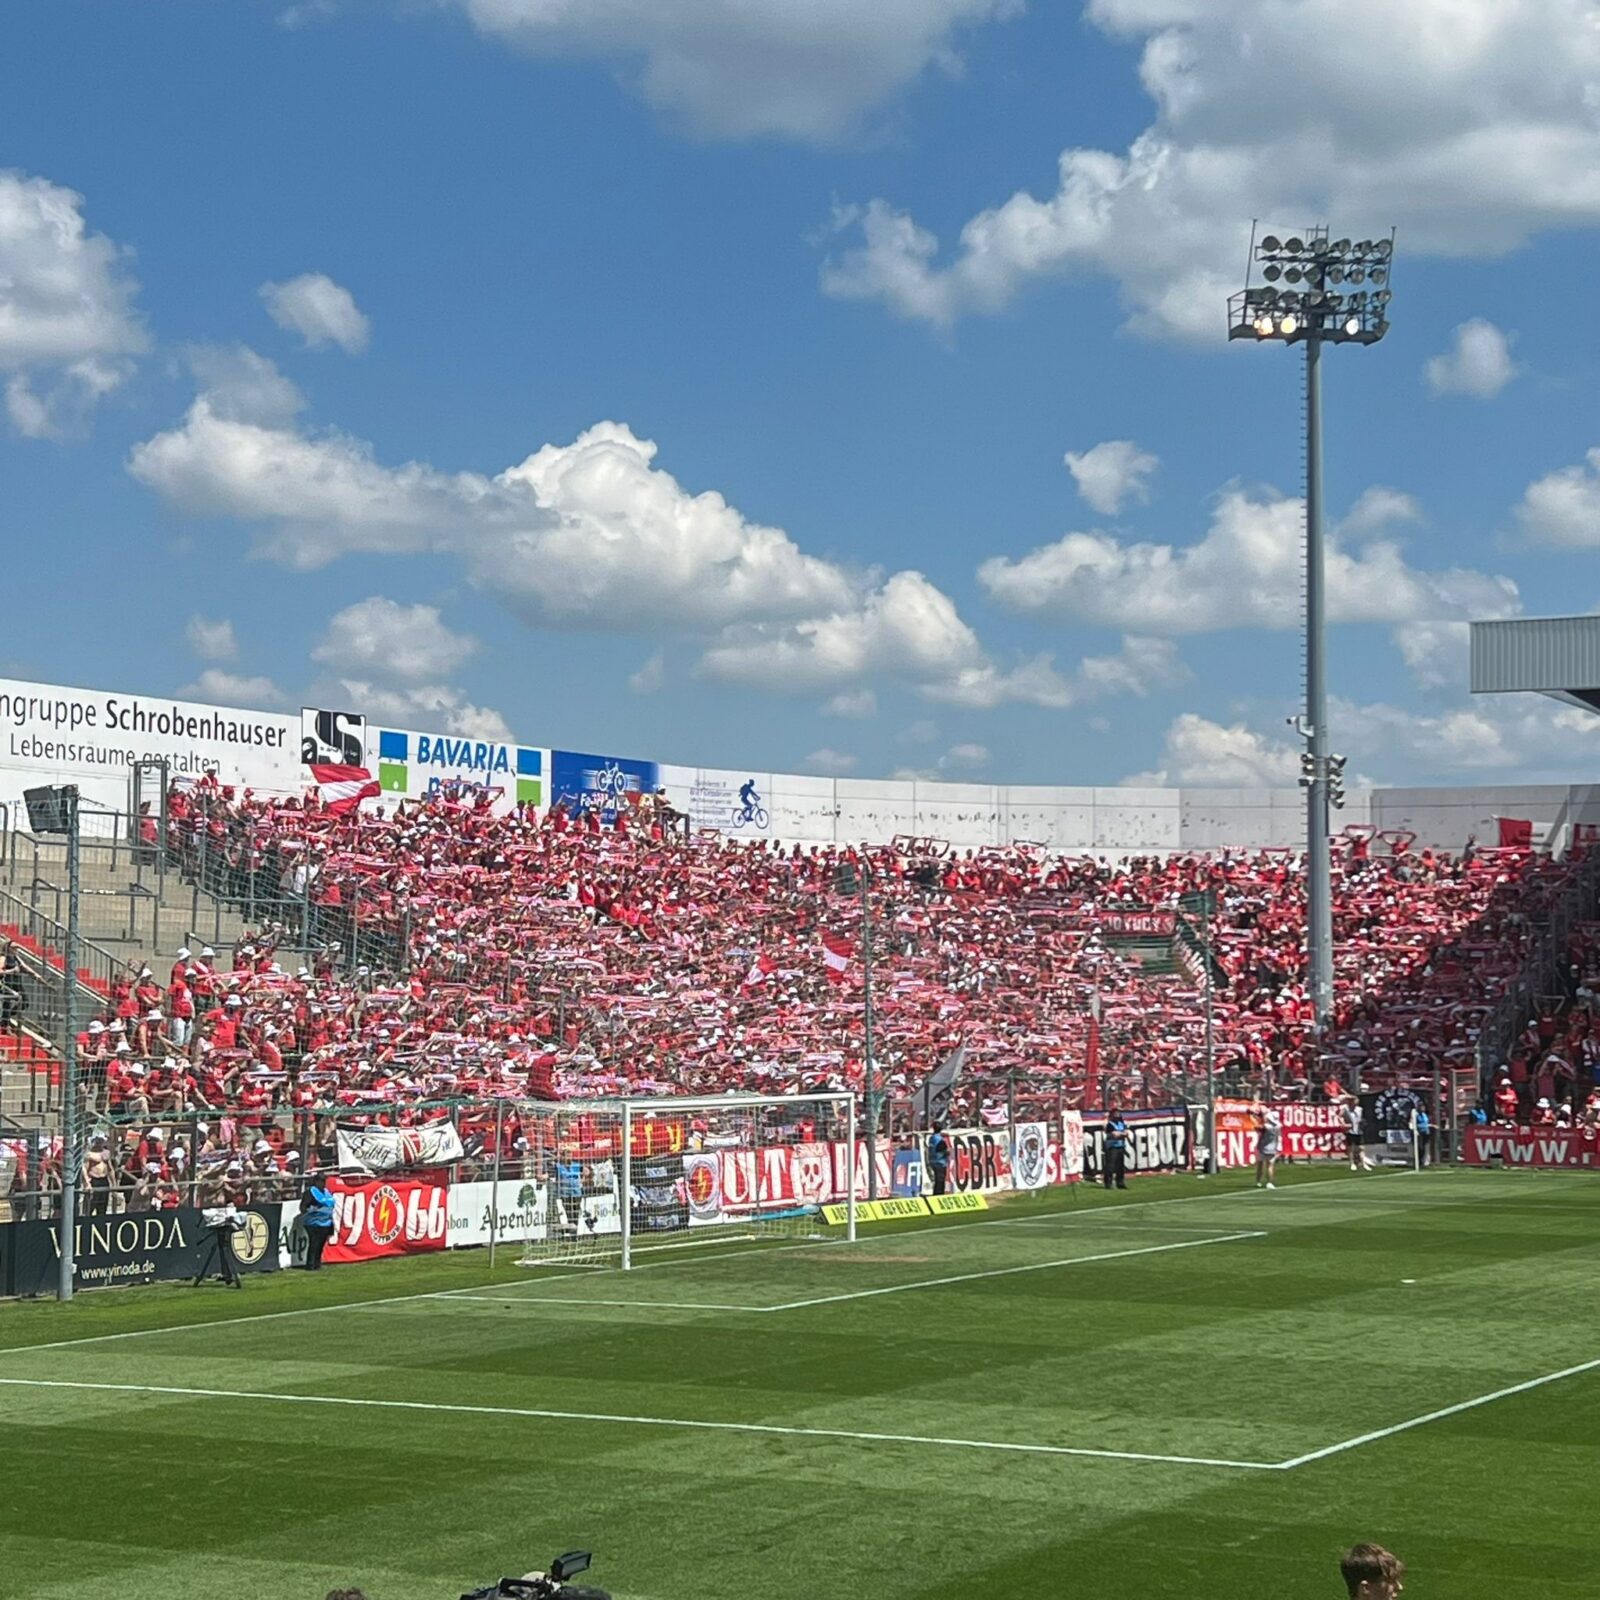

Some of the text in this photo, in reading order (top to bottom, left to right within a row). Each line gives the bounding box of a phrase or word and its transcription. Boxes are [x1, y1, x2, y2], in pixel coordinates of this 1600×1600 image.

[105, 699, 287, 748] Schrobenhauser
[142, 750, 221, 776] gestalten
[417, 735, 509, 773] BAVARIA
[479, 1204, 548, 1238] Alpenbau
